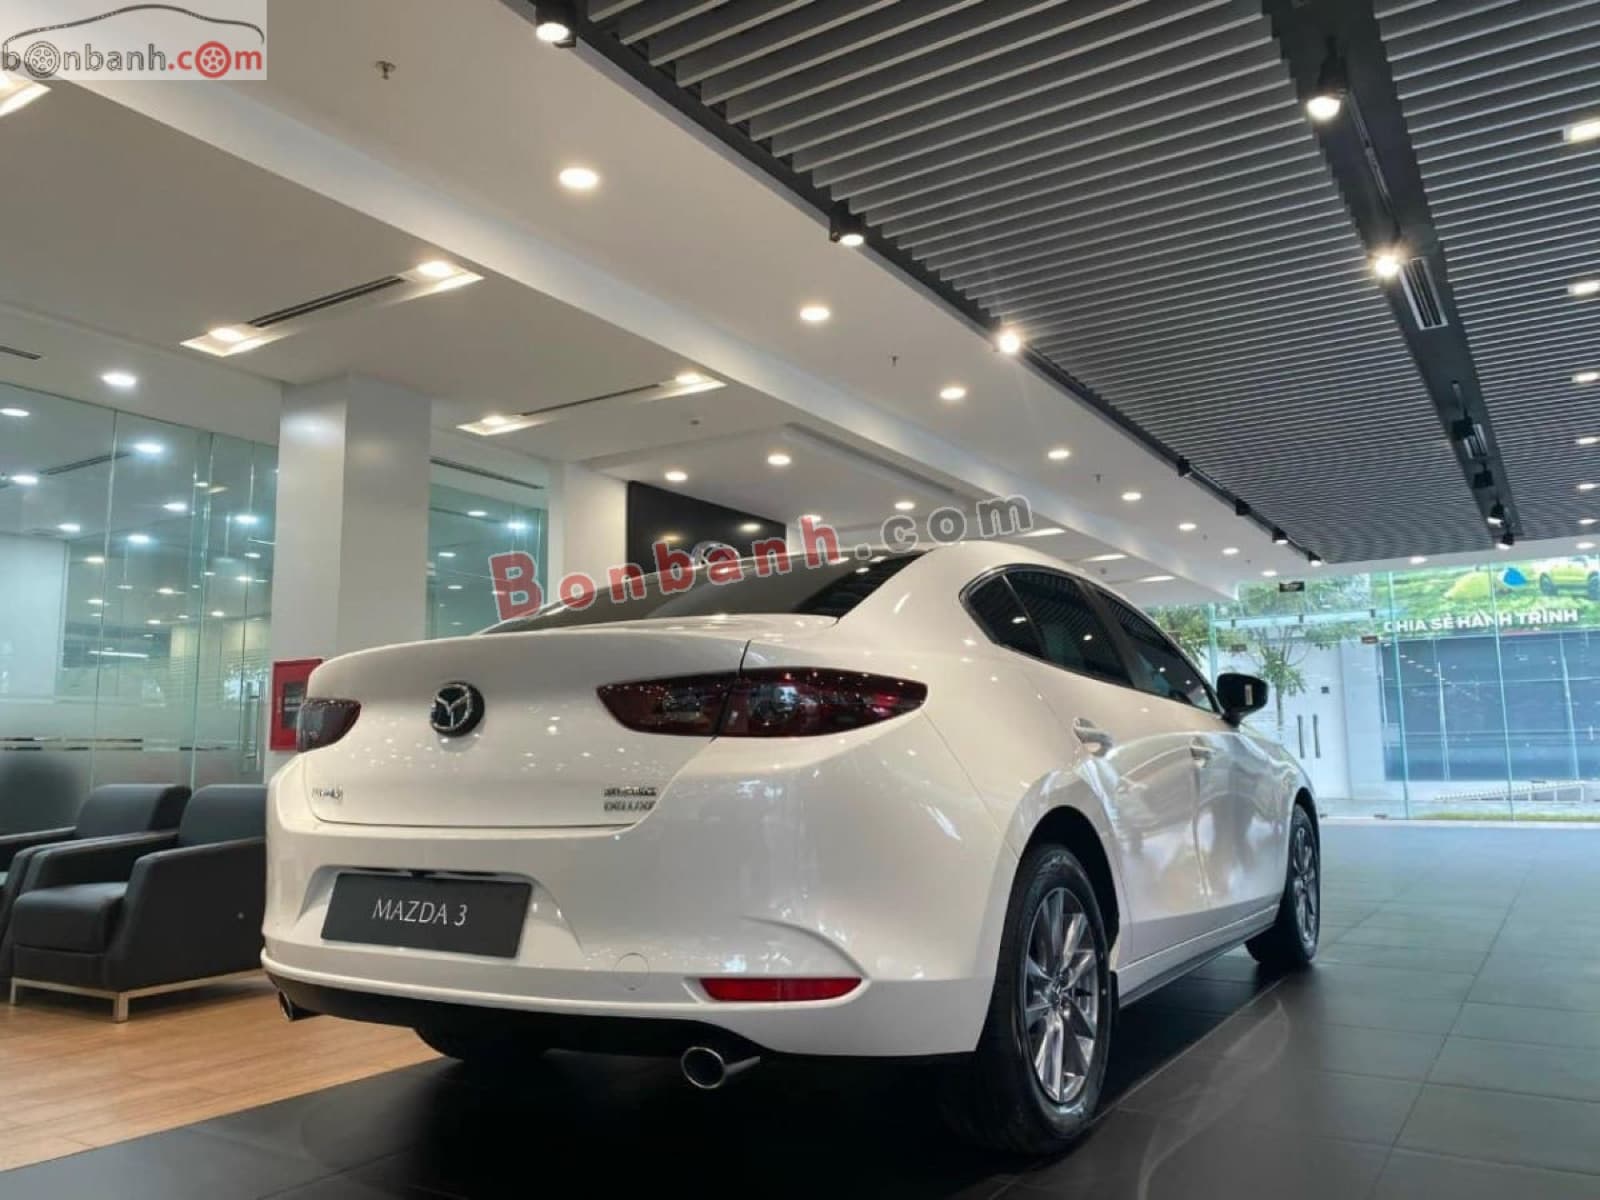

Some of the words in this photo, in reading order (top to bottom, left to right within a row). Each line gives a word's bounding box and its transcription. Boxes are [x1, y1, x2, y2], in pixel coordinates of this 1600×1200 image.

[1383, 619, 1428, 633] CHIA
[371, 899, 448, 926] MAZDA
[453, 904, 468, 927] 3
